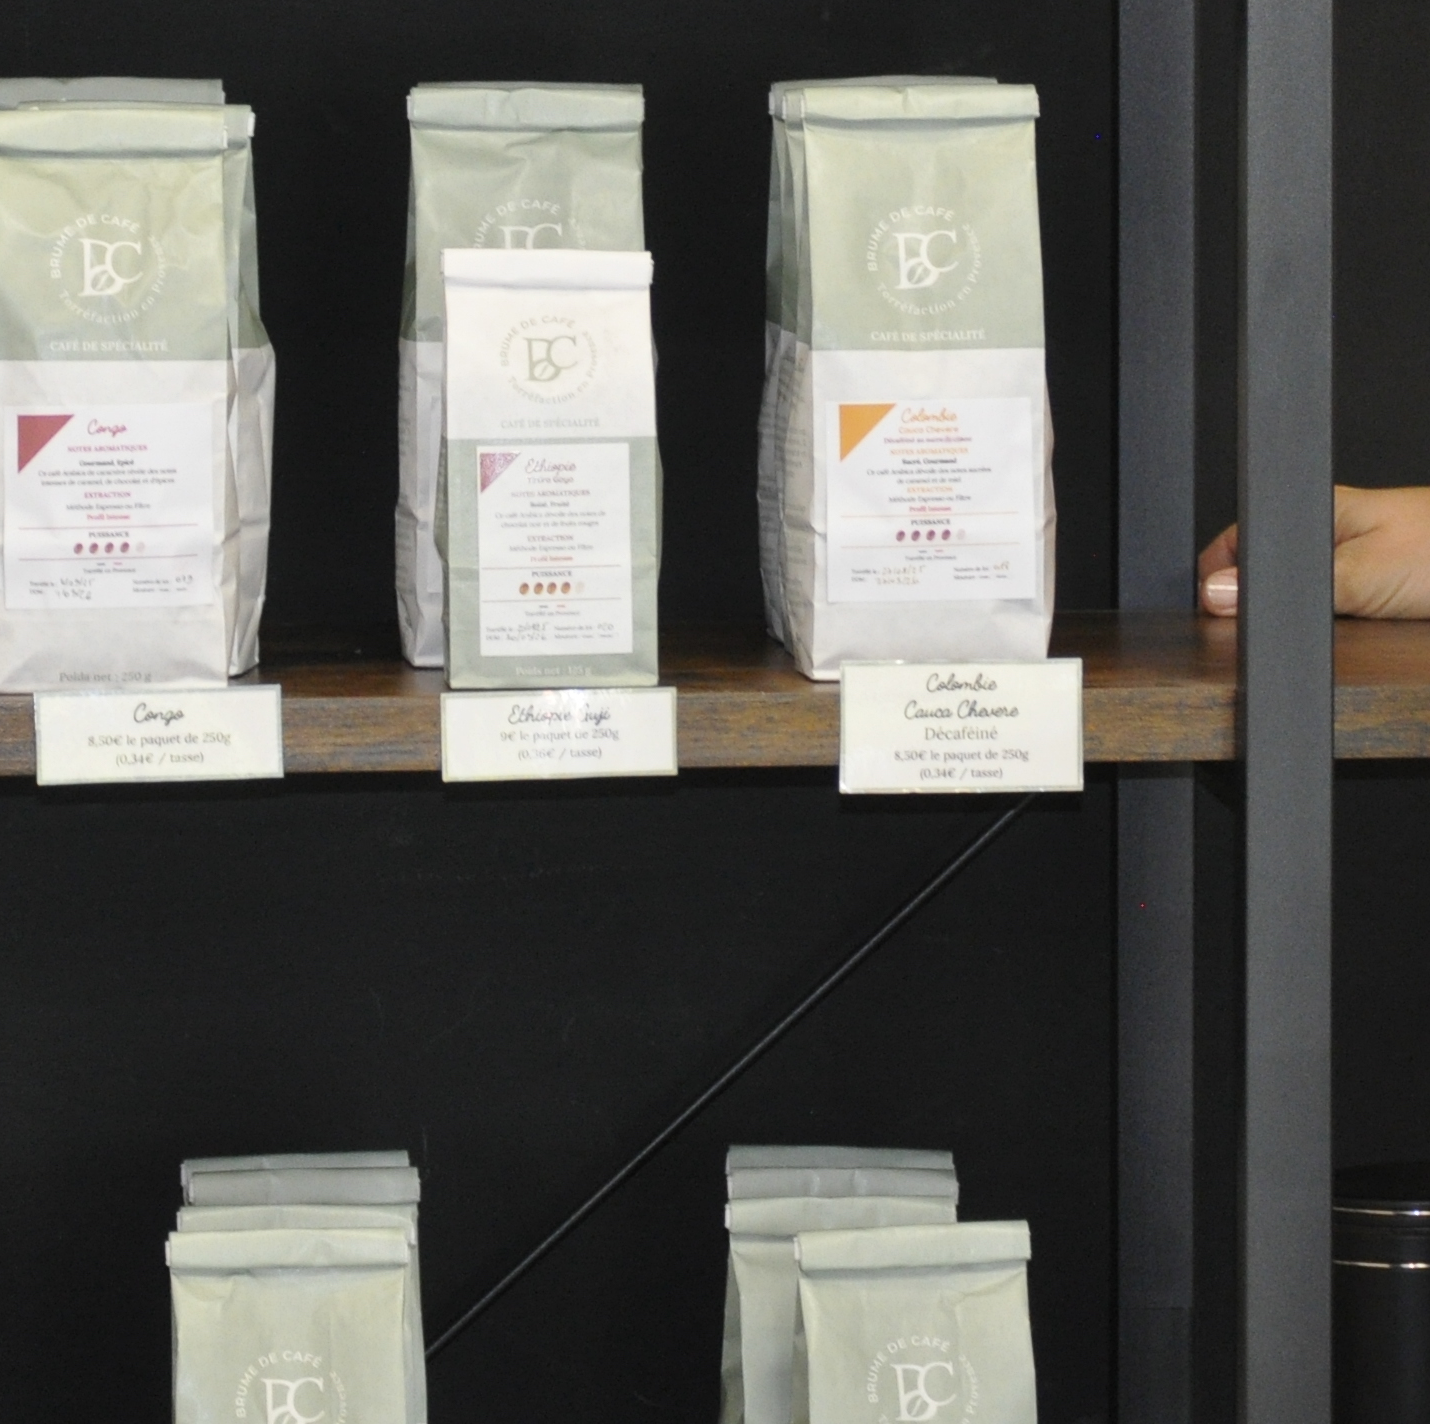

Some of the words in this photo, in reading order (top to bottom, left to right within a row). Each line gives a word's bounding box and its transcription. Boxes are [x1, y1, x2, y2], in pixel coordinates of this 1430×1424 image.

[889, 207, 911, 222] DE
[901, 408, 958, 424] Colombie
[87, 419, 127, 437] Congo
[926, 673, 997, 693] Colombie
[133, 702, 184, 726] Congo
[904, 700, 952, 719] Cauca
[957, 700, 1019, 719] Chevere
[126, 735, 136, 745] le
[140, 735, 180, 748] paquet
[184, 733, 198, 744] de
[202, 732, 232, 746] 250g
[500, 732, 516, 742] 9€
[520, 731, 530, 741] le
[533, 730, 571, 744] paquet
[591, 728, 620, 742] 250g
[924, 726, 998, 741] Décaféiné
[930, 750, 940, 760] le
[943, 750, 982, 763] paquet
[985, 749, 999, 760] de
[1002, 749, 1029, 762] 250g
[867, 1351, 888, 1403] BRUME
[886, 1337, 908, 1353] DE
[235, 1364, 259, 1418] BRUME
[258, 1351, 279, 1368] DE
